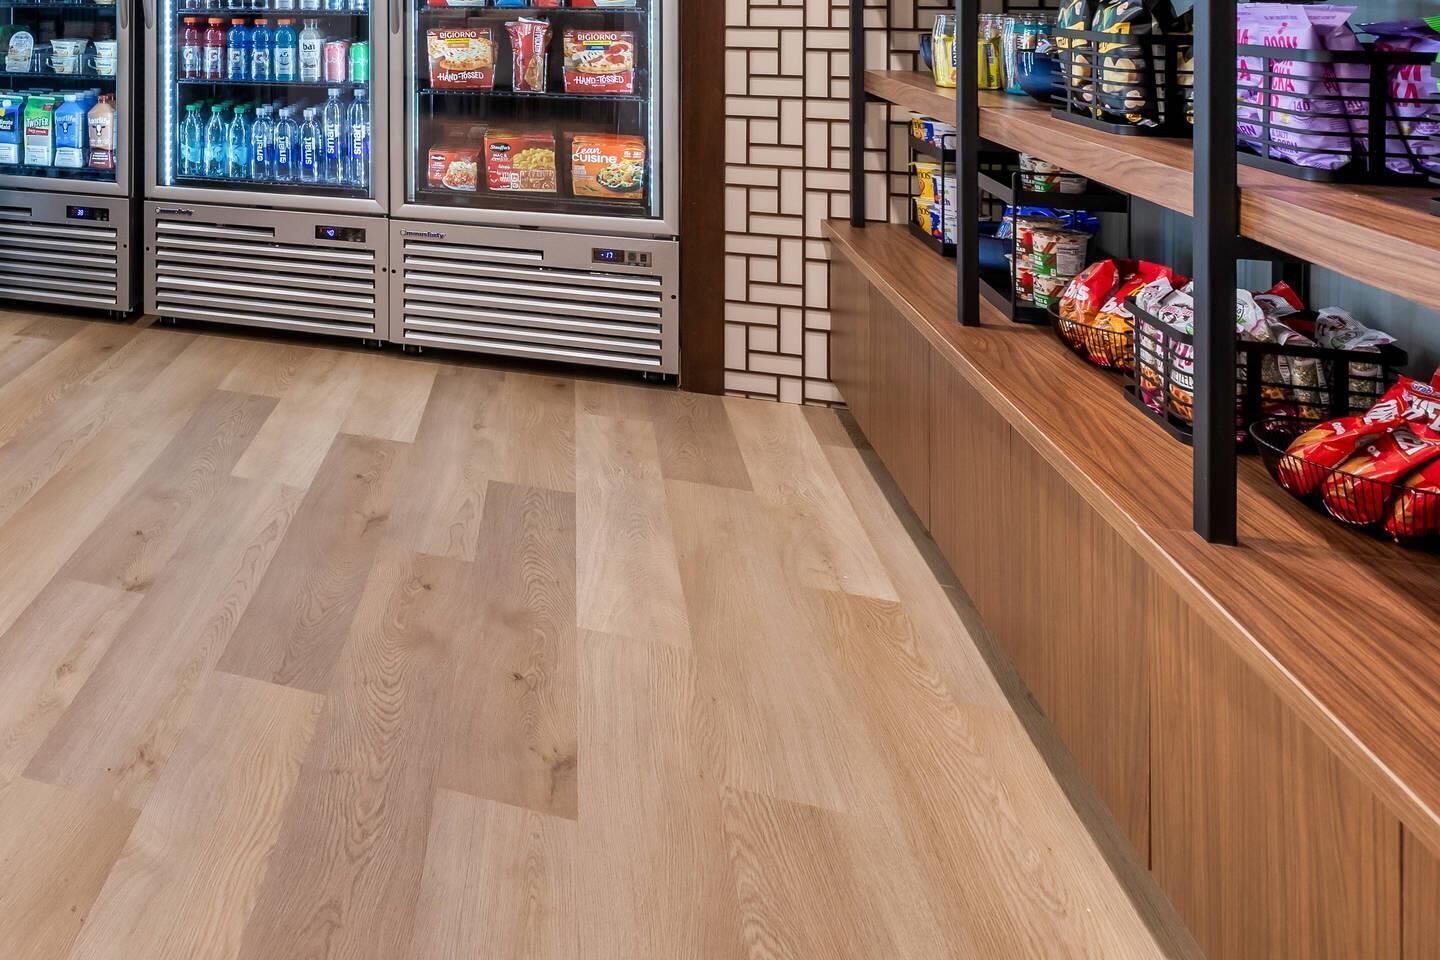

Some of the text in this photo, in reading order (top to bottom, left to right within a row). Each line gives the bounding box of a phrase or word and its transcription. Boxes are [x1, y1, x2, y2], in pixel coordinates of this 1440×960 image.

[305, 137, 313, 165] smart
[327, 124, 335, 154] smart
[353, 124, 362, 155] smart
[576, 146, 602, 155] Lean
